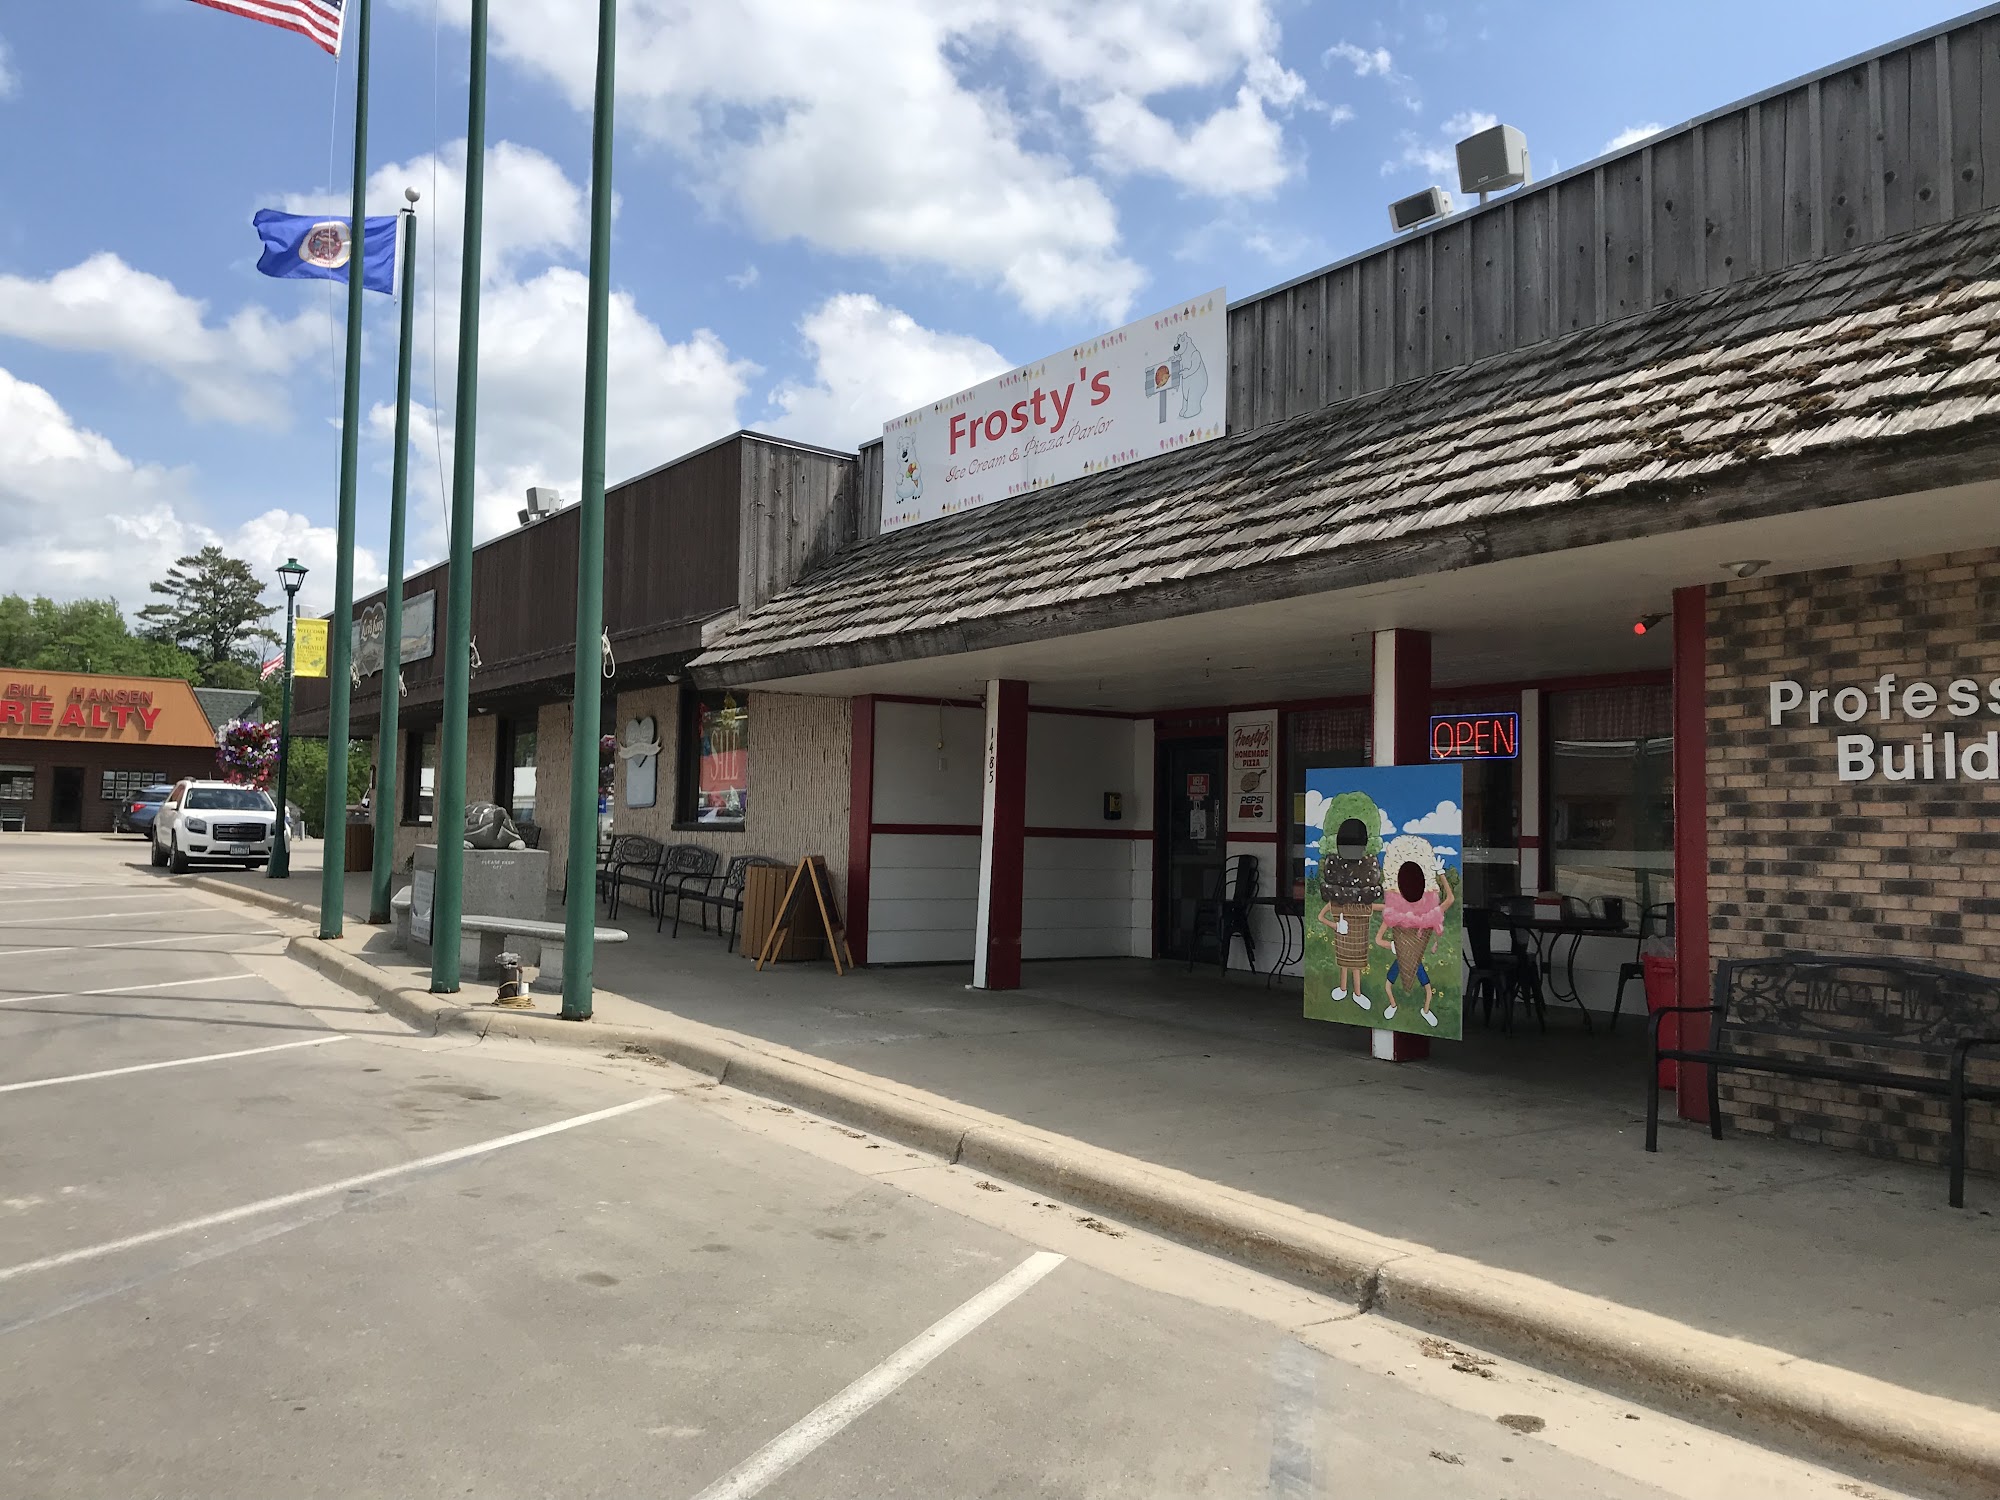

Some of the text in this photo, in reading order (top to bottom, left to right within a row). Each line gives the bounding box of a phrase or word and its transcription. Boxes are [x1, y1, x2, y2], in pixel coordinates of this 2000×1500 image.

[949, 366, 1111, 456] Frosty's
[945, 416, 1114, 483] Ice Cream & Pizza Parlor
[8, 683, 153, 705] BILL HANSEN
[0, 699, 162, 731] REALTY
[710, 729, 740, 780] SALE
[1235, 750, 1269, 759] HOMEMADE
[1434, 718, 1514, 758] OPEN
[1837, 730, 2000, 782] Build
[1242, 759, 1260, 767] PIZZA
[1240, 795, 1265, 804] PEPSI
